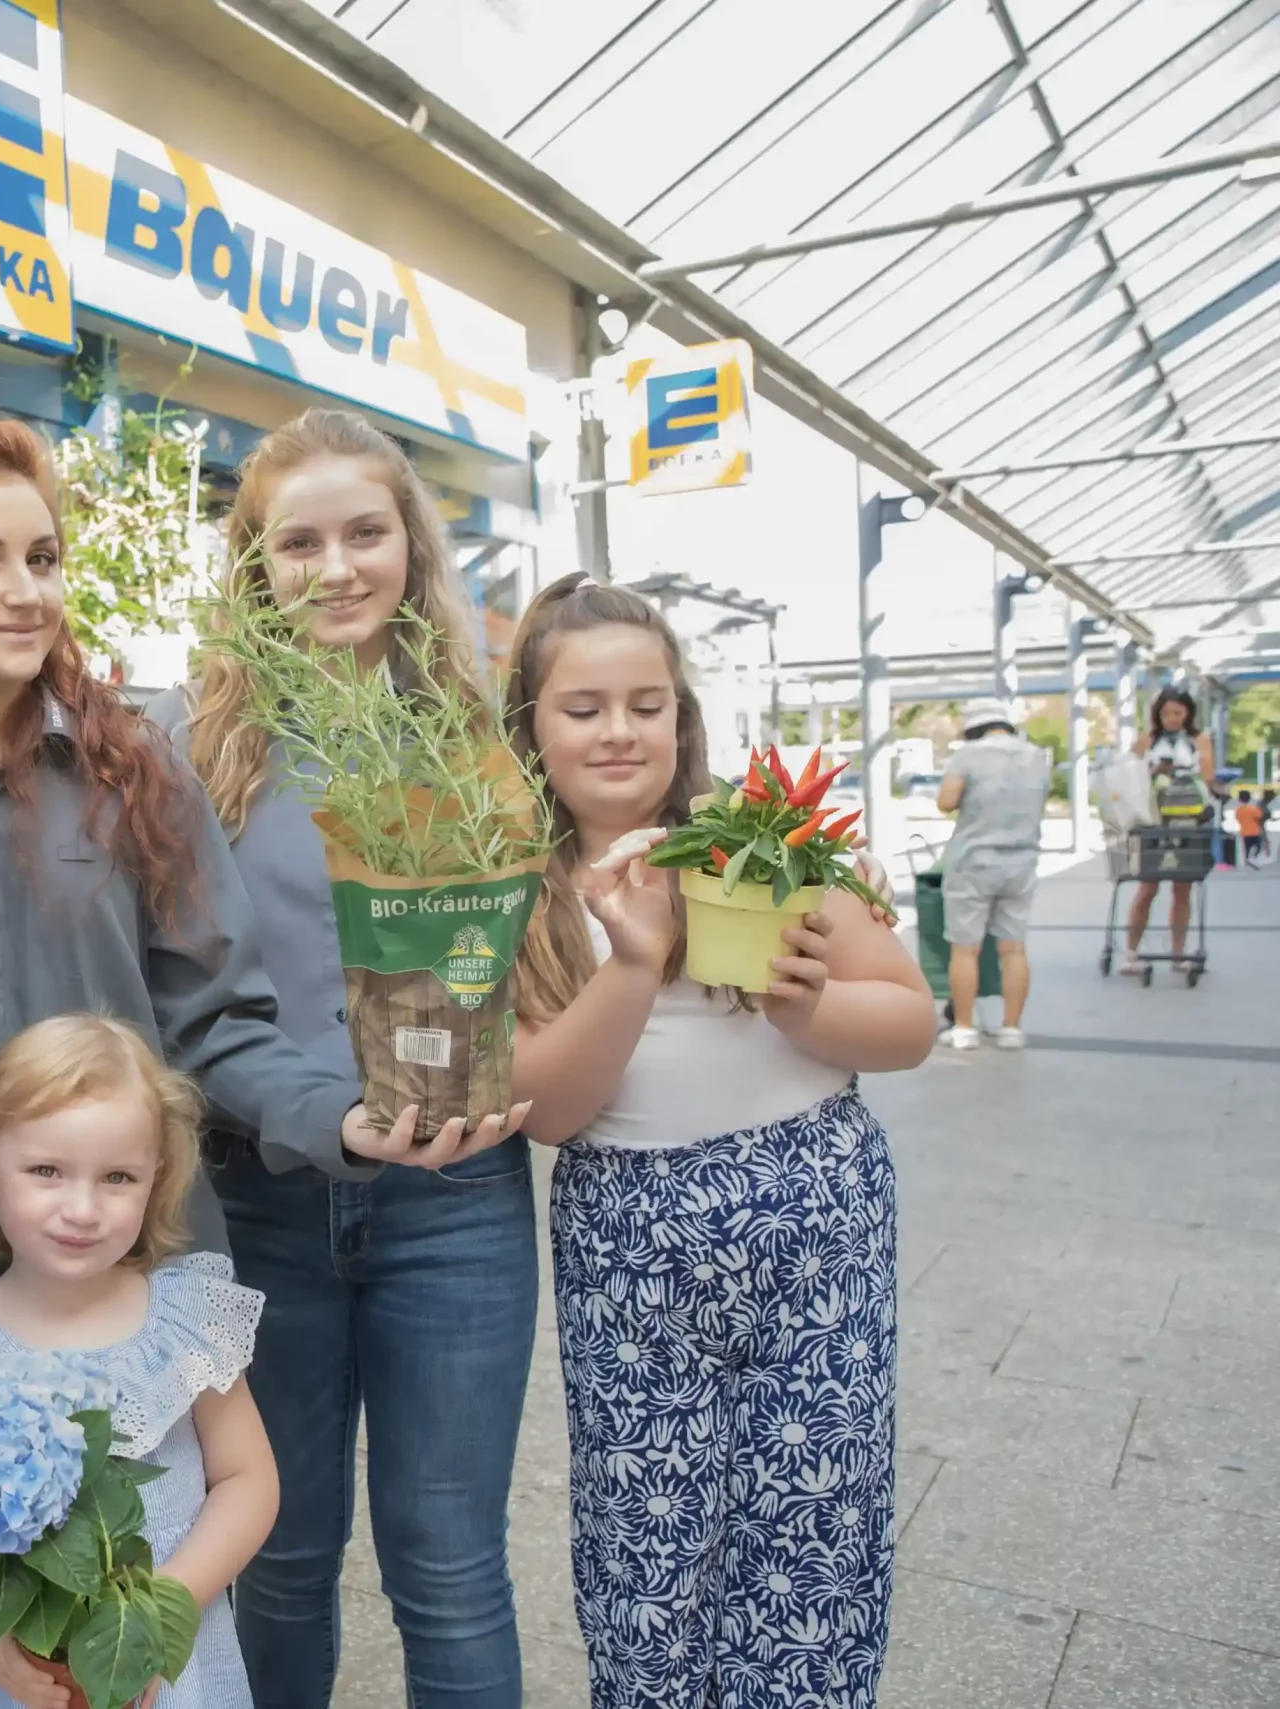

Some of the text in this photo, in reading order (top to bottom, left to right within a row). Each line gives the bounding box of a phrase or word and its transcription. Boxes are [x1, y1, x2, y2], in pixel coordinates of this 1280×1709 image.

[104, 148, 410, 367] Bauer
[448, 958, 494, 969] UNSERE
[448, 970, 493, 981] HEIMAT
[460, 993, 482, 1005] BIO
